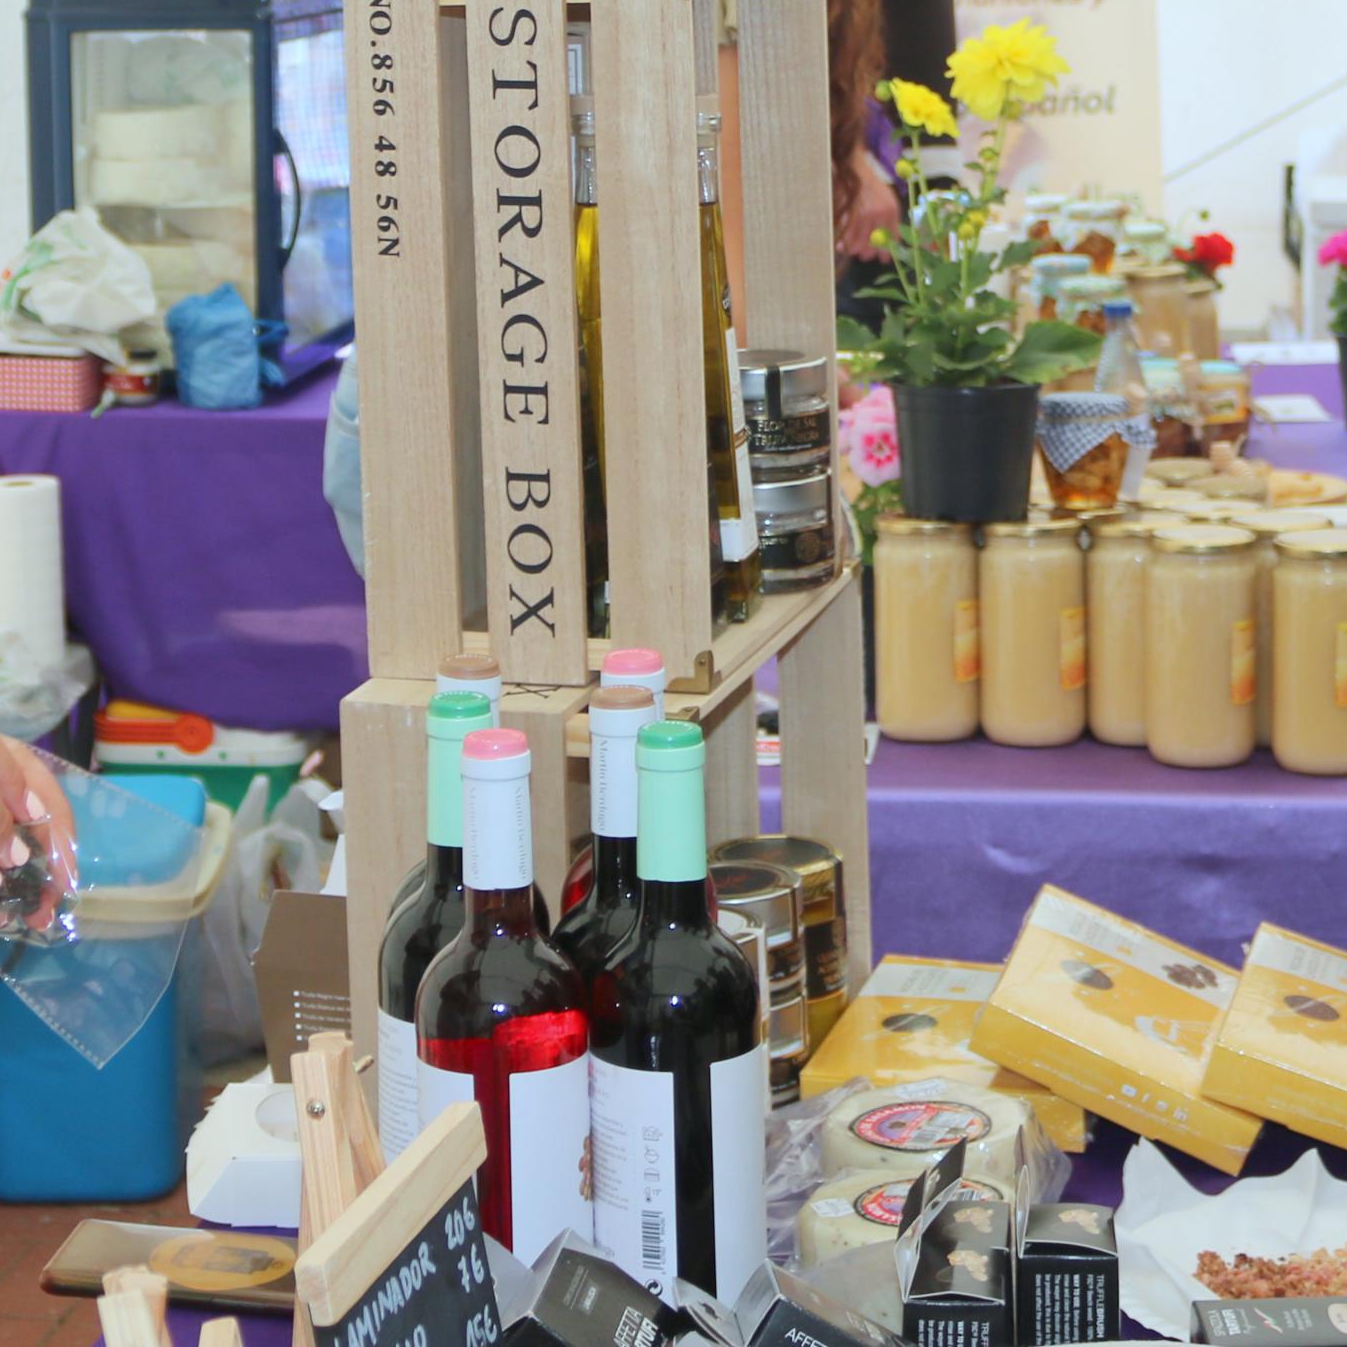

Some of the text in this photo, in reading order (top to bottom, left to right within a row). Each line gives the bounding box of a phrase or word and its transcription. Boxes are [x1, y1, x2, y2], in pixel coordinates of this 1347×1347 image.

[373, 134, 399, 179] 48
[487, 5, 551, 427] STORAGE
[375, 193, 401, 259] 56N
[503, 464, 557, 639] BOX
